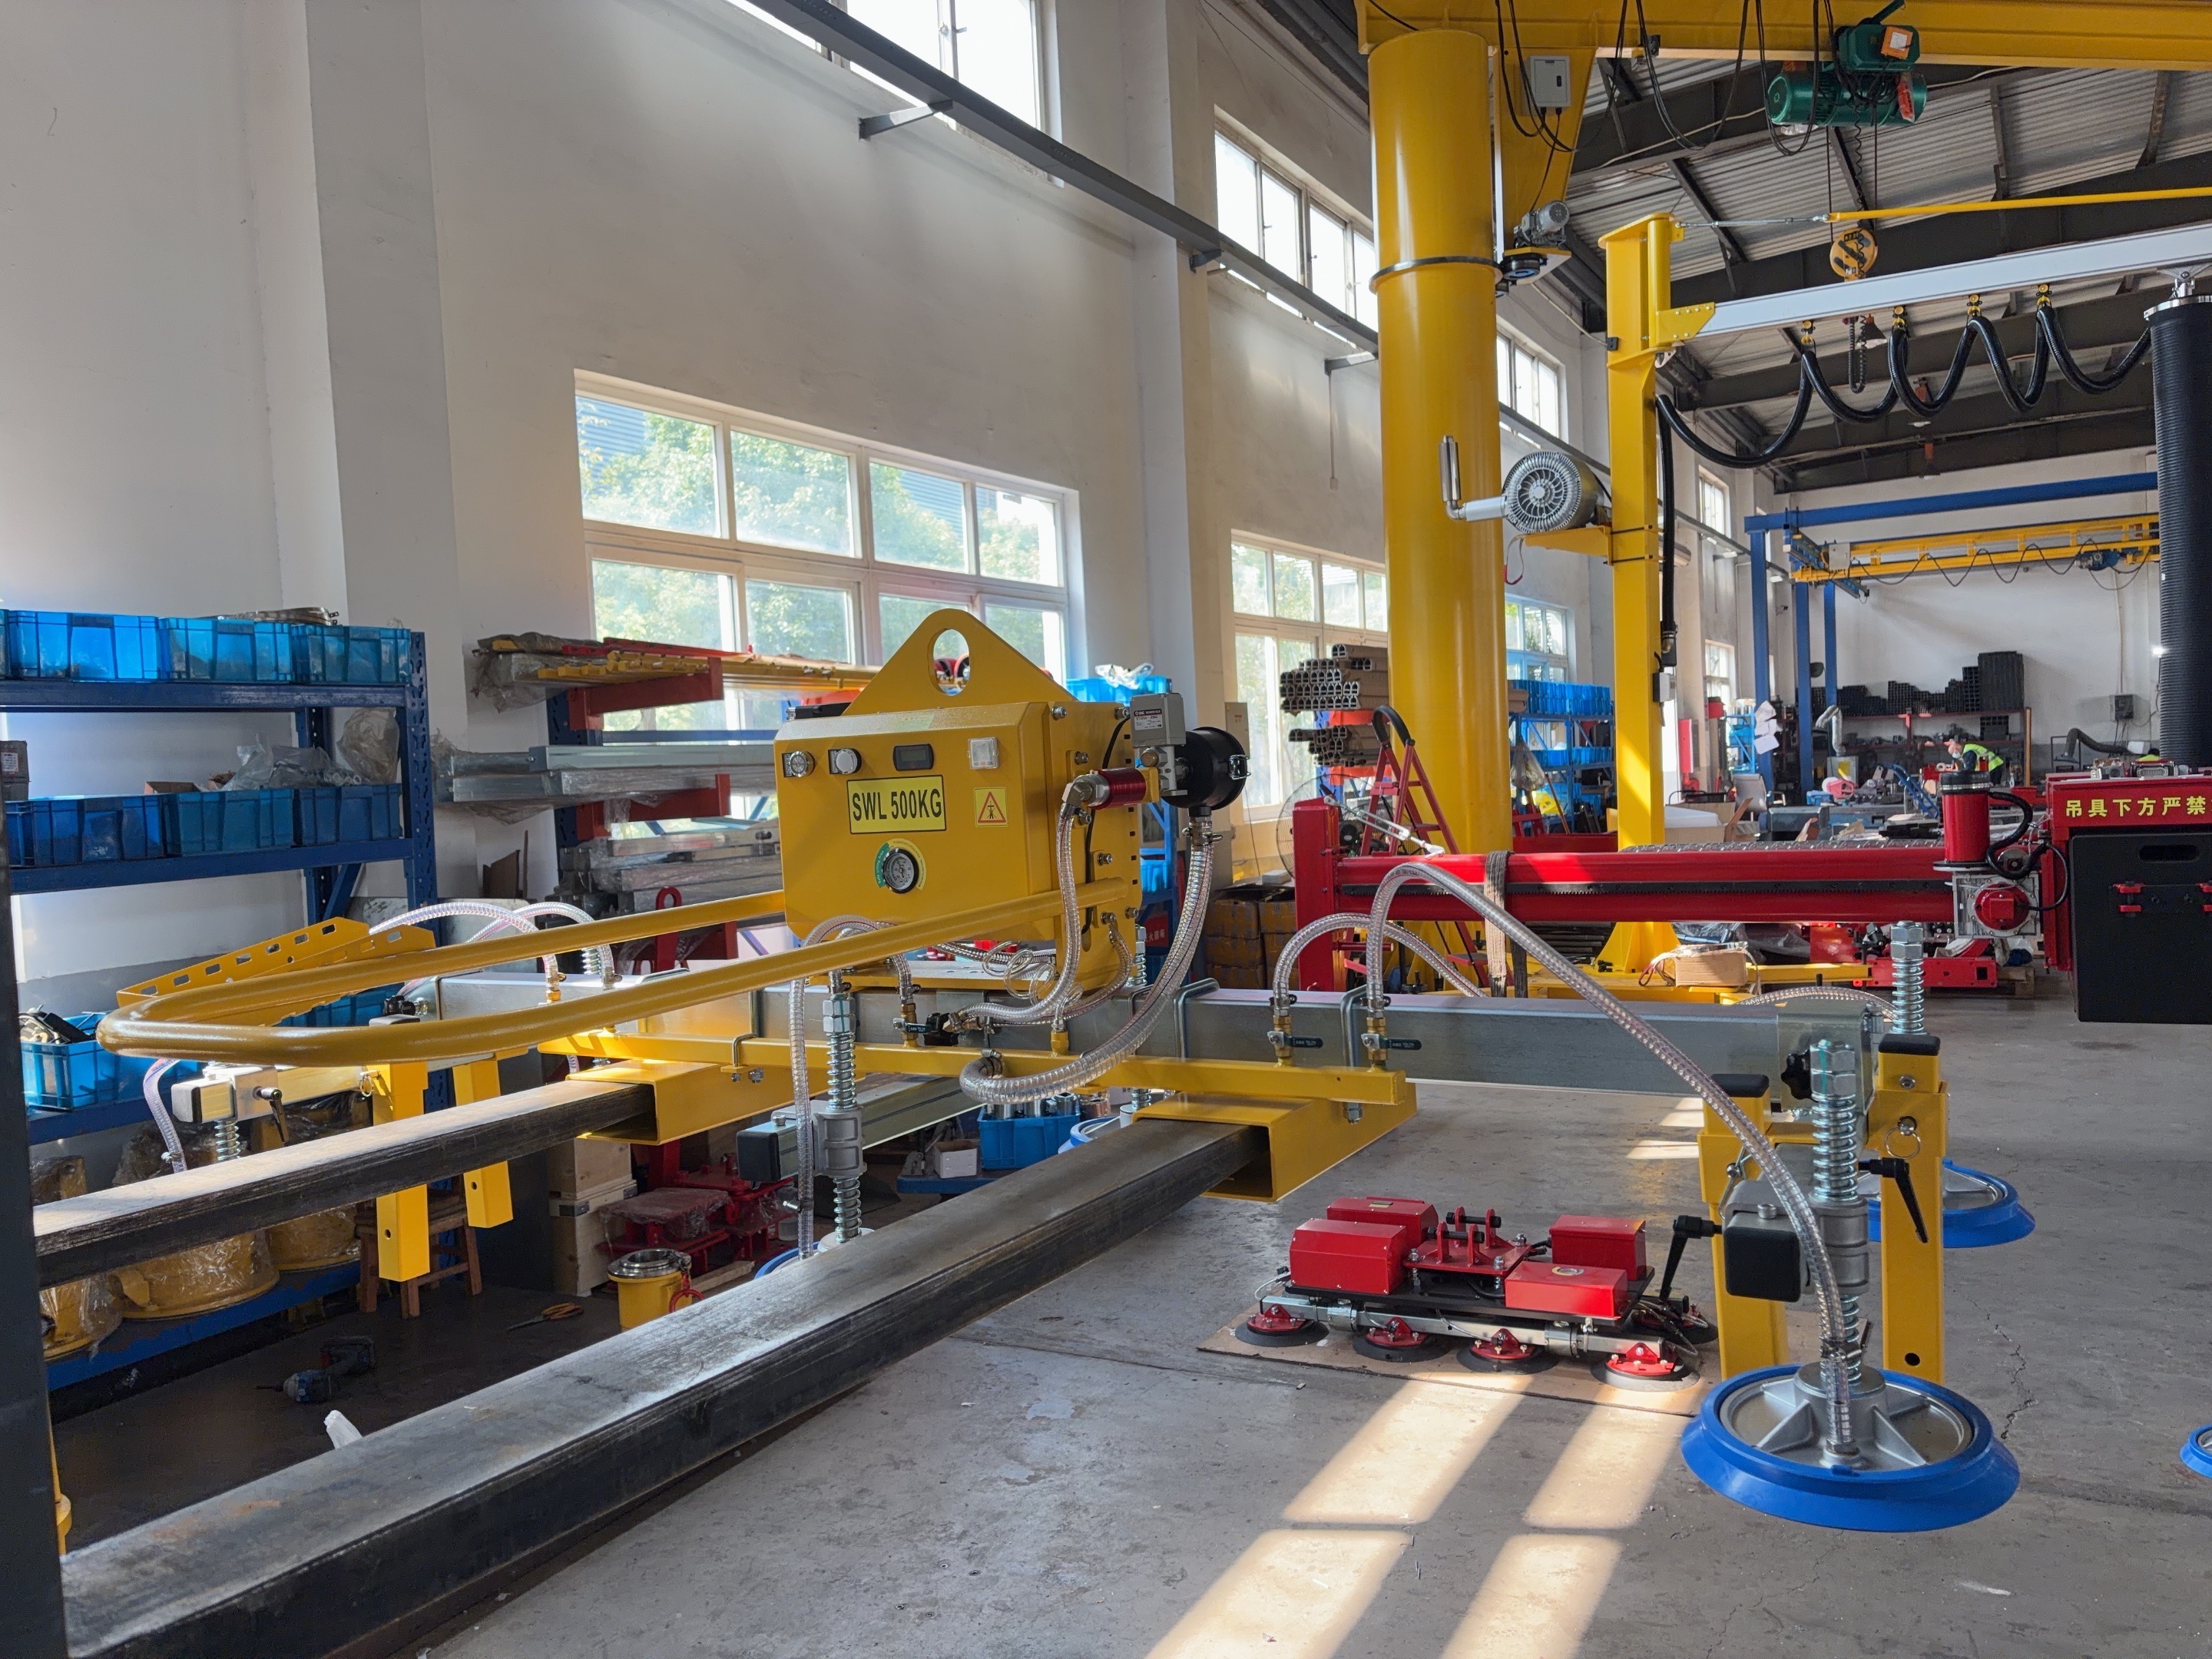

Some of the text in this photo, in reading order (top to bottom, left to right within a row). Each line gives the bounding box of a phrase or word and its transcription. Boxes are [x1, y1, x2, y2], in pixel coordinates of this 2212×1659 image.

[852, 788, 942, 821] SWL 500KG
[2066, 796, 2212, 818] 吊具下方严禁
